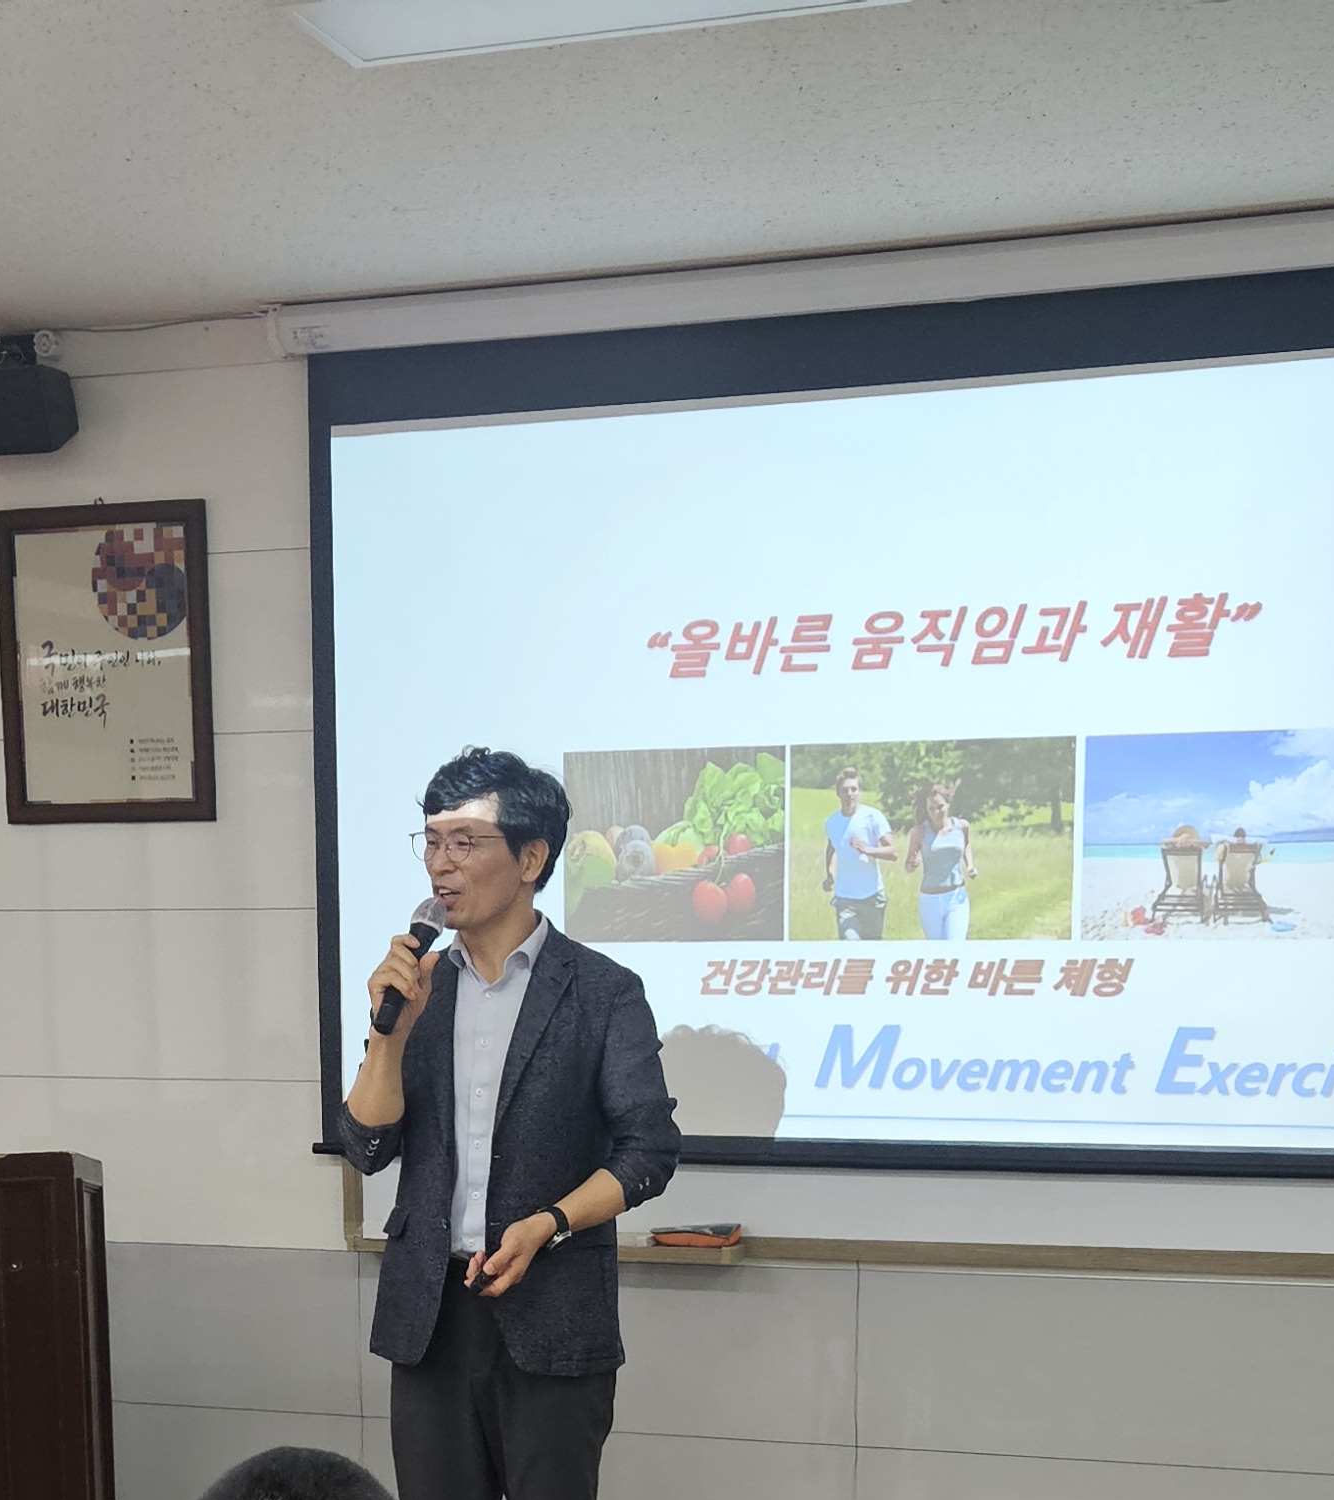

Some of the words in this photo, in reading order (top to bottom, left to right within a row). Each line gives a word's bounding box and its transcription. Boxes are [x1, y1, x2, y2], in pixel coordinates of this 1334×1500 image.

[645, 613, 835, 680] “올바른
[849, 603, 1087, 672] 움직임과
[1099, 591, 1263, 660] 재활”
[41, 640, 87, 676] 국민이
[94, 650, 130, 671] 주인인
[40, 677, 69, 695] 함께
[72, 674, 106, 693] 행복한
[41, 693, 110, 729] 대한민국
[700, 958, 874, 996] 건강관리를
[884, 958, 959, 996] 위한
[967, 958, 1044, 996] 바른
[1053, 957, 1135, 998] 체형
[814, 1023, 1135, 1093] Movement
